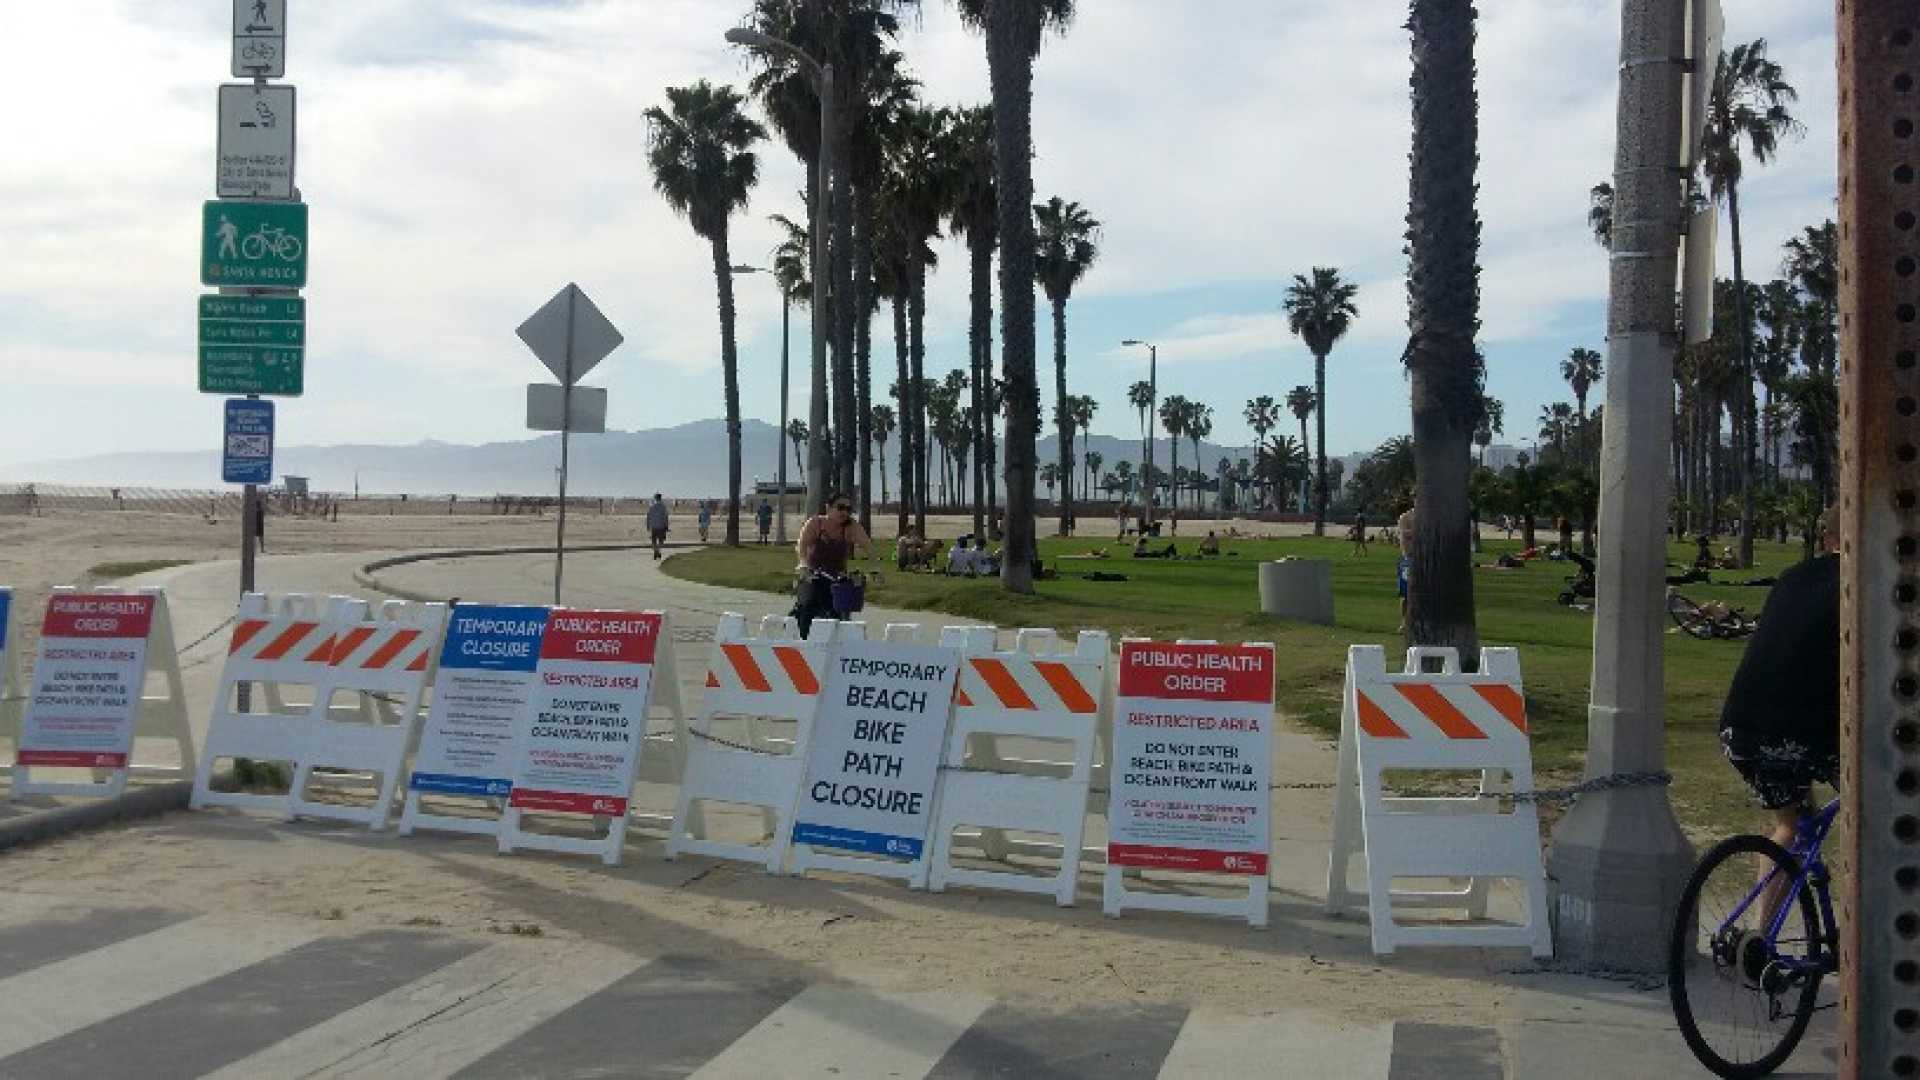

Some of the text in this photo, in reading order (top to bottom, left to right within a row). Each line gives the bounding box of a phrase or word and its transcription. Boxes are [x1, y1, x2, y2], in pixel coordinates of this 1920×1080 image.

[53, 600, 147, 615] PUBLIC HEALTH
[74, 617, 119, 632] ORDER
[456, 617, 547, 637] TEMPORARY
[553, 618, 651, 636] PUBLIC HEALTH
[462, 638, 531, 657] CLOSURE
[575, 639, 622, 655] ORDER
[840, 658, 948, 681] TEMPORARY
[1131, 651, 1263, 672] PUBLIC HEALTH
[1164, 674, 1226, 693] ORDER
[847, 686, 927, 714] BEACH
[1128, 711, 1260, 733] RESTRICTED AREA
[854, 719, 907, 745] BIKE
[1145, 742, 1239, 759] DO NOT ENTER
[842, 750, 904, 778] PATH
[1178, 759, 1206, 773] BIKE
[1207, 761, 1241, 775] PATH
[1220, 780, 1257, 792] WALK
[811, 780, 924, 815] CLOSURE
